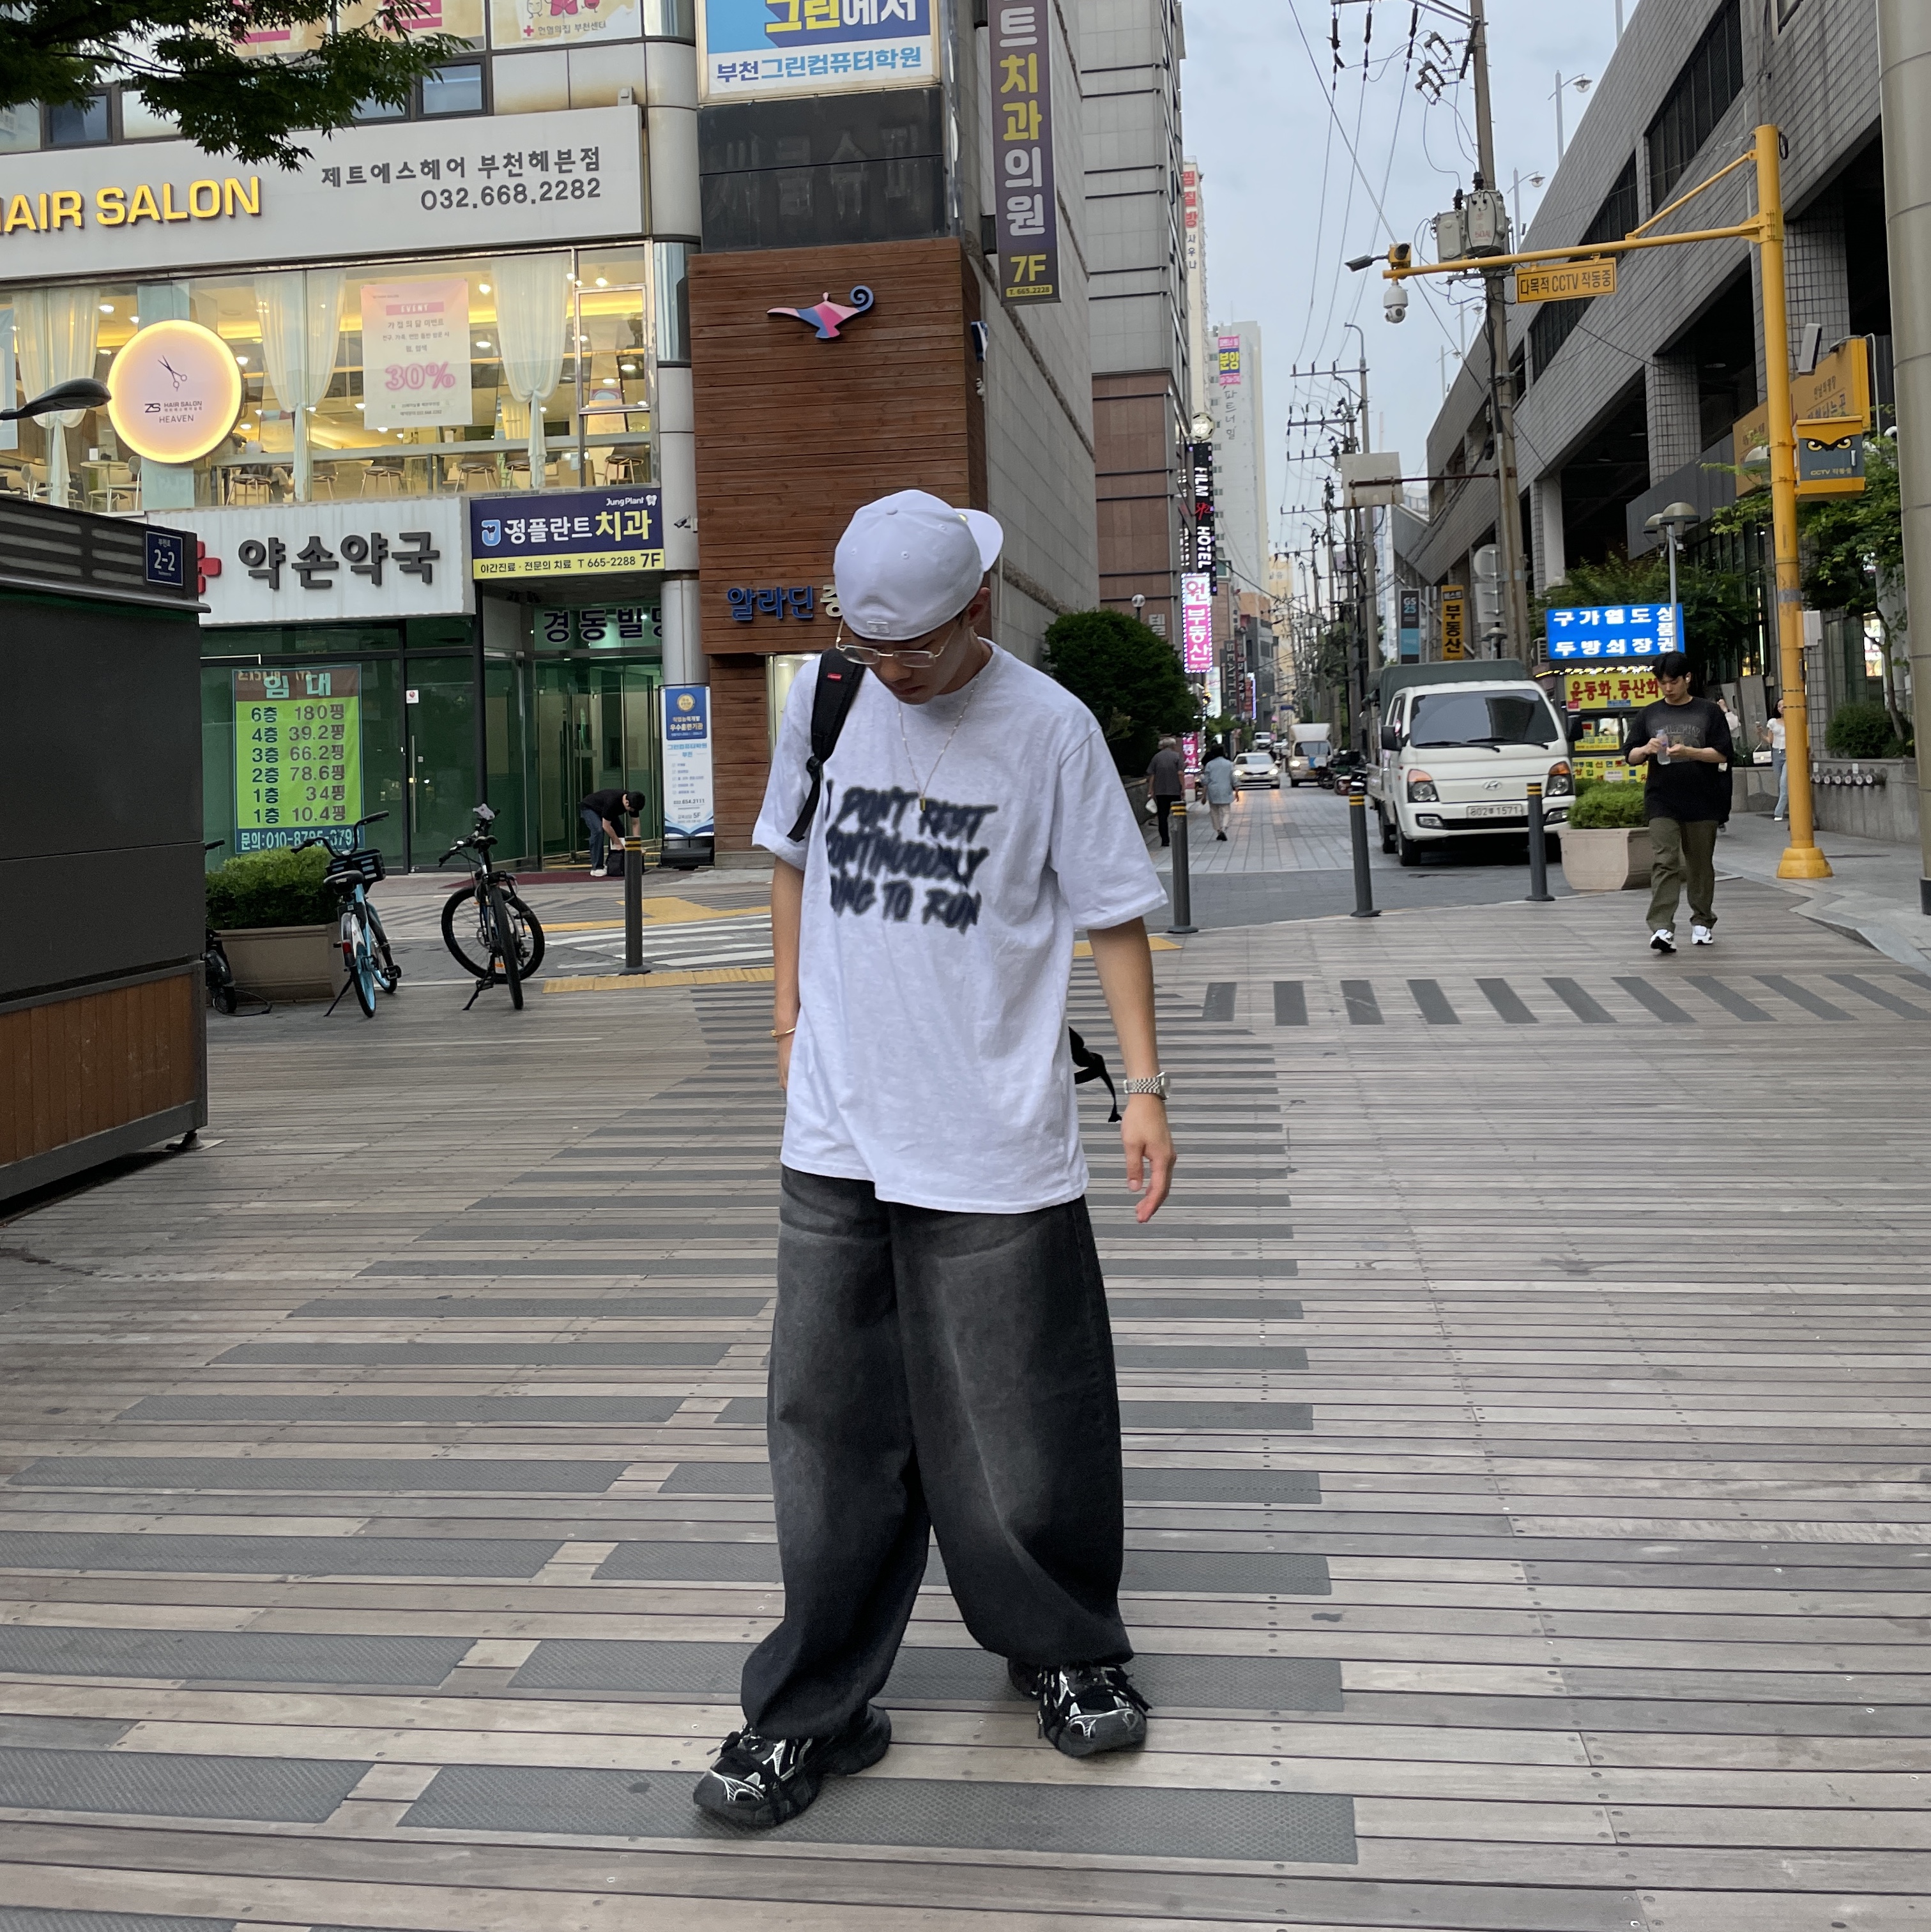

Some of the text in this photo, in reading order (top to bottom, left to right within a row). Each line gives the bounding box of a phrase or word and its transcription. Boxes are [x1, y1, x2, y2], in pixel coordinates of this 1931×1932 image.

[321, 146, 600, 188] 제트에스헤어 부천헤븐점
[0, 176, 262, 233] AIR SALON
[421, 177, 601, 210] 032.668.2282
[1011, 254, 1046, 282] 7F
[1520, 270, 1611, 295] 다목적 CCTV 작동중
[401, 304, 429, 313] EVENT
[385, 361, 455, 391] 30%
[159, 415, 194, 423] HEAVEN
[1194, 466, 1209, 497] FILM
[154, 549, 175, 572] 2-2
[238, 531, 441, 590] 약손약국
[1196, 526, 1212, 569] HOTEL
[480, 561, 516, 574] 야간진료
[524, 560, 551, 571] 전문의
[554, 559, 572, 570] 치료
[587, 556, 636, 567] 665-2288
[640, 552, 661, 568] 7F
[727, 586, 814, 621] 알라딘
[1403, 597, 1417, 605] GS
[1403, 605, 1417, 614] 25
[543, 605, 662, 643] 경동빌
[1187, 608, 1210, 662] 부동산
[1444, 605, 1462, 653] 부동산
[1226, 643, 1237, 706] SEATTLE
[251, 703, 345, 723] 6층 180평
[252, 724, 346, 743] 4층 39.2평
[252, 744, 345, 764] 3층 66.2평
[252, 764, 346, 784] 2층 78.6평
[254, 784, 346, 804] 1층 34평
[254, 805, 346, 825] 1층 10.4평
[883, 879, 913, 922] TO
